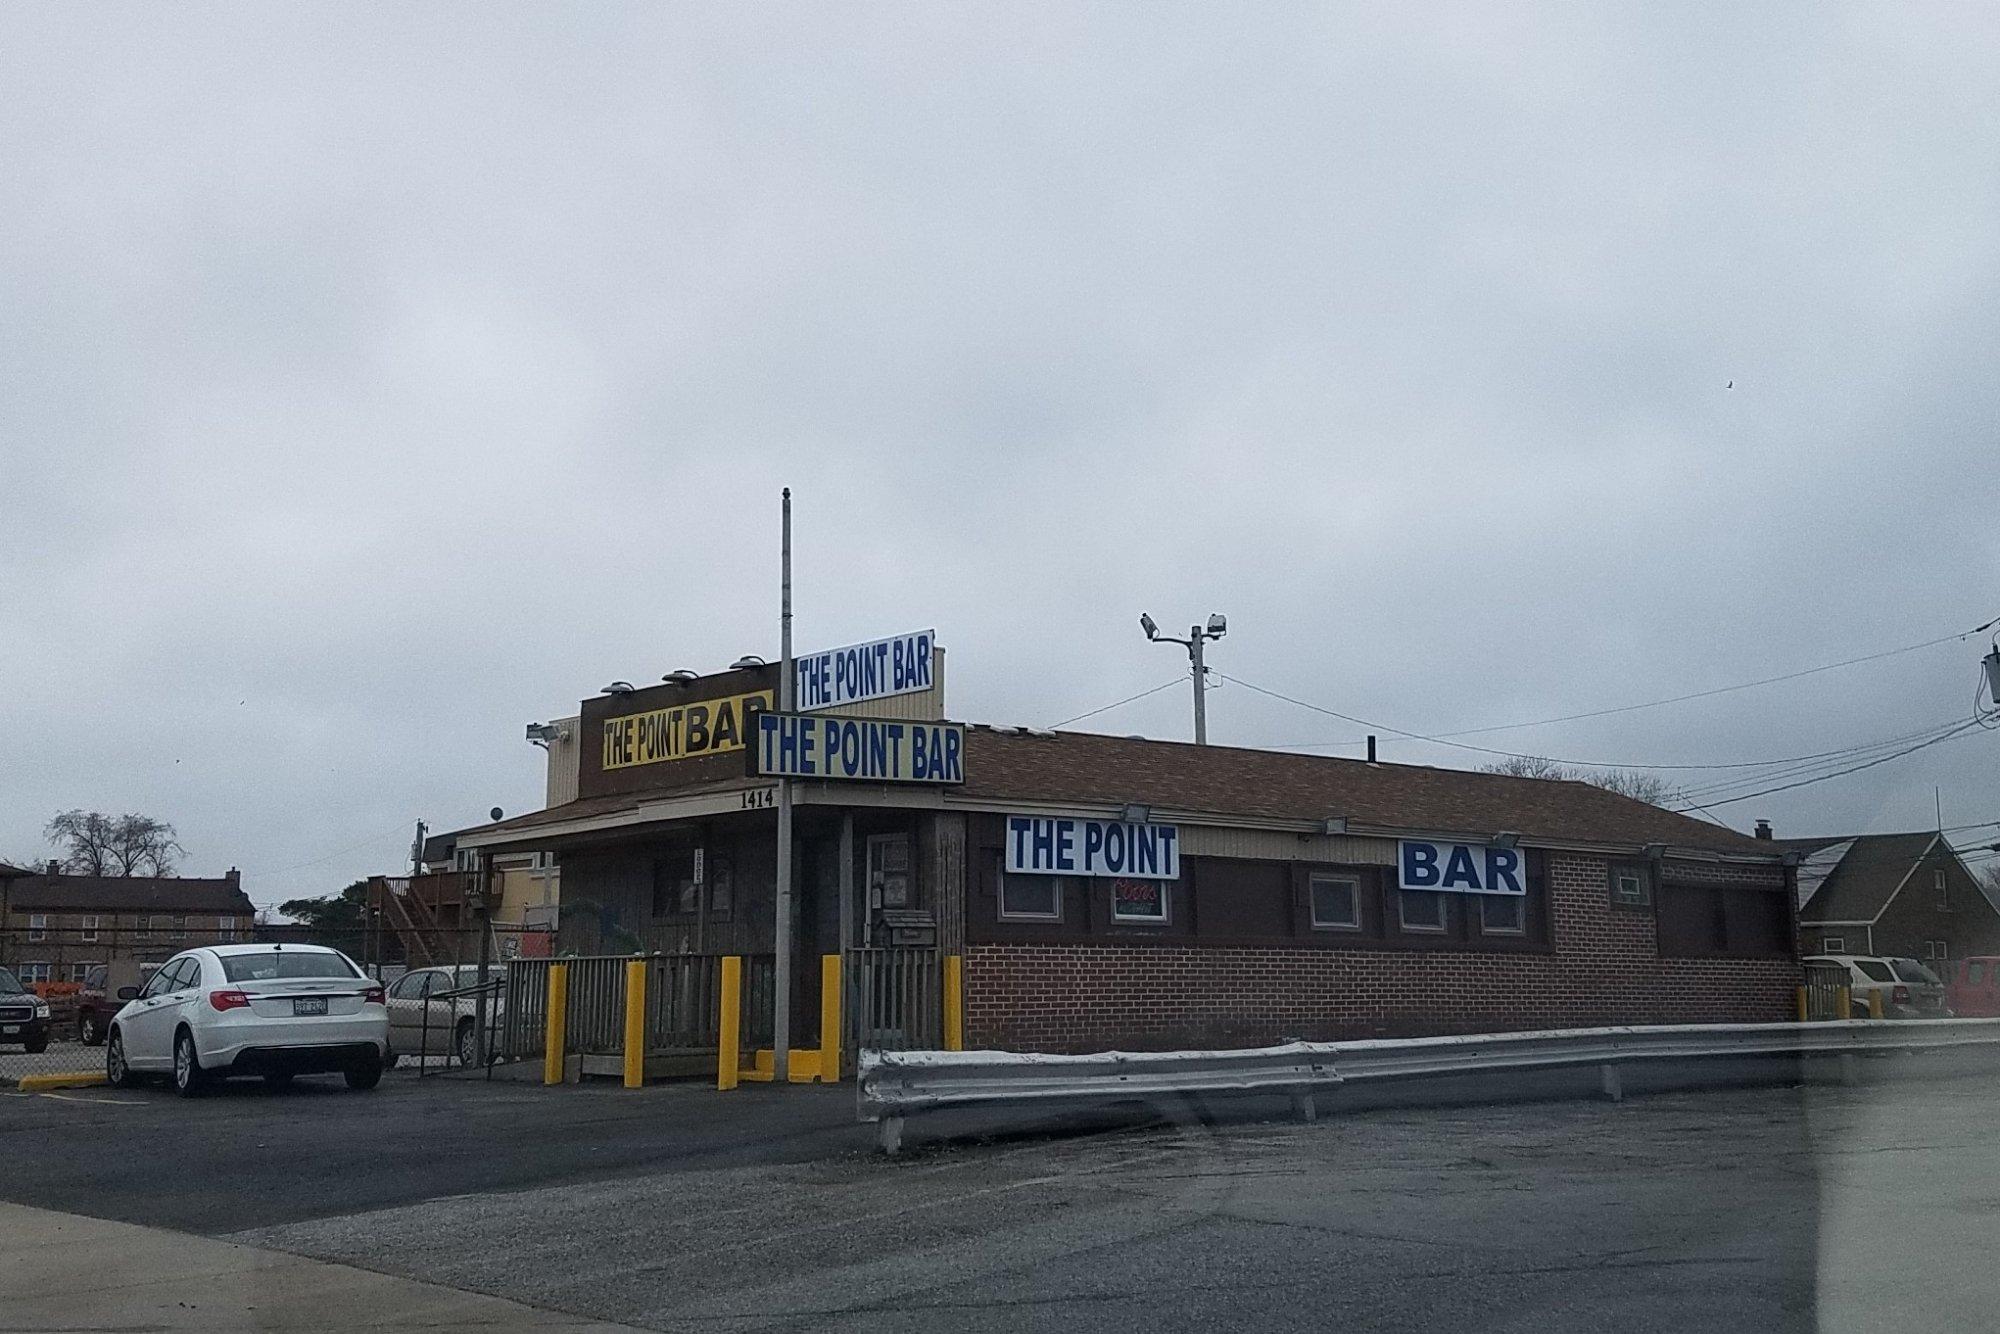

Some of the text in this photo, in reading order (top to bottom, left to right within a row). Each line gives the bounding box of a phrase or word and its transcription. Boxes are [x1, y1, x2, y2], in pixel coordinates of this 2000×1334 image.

[800, 635, 930, 707] THE POINT BAR
[605, 719, 633, 766] THE
[638, 709, 684, 761] POINT
[761, 715, 961, 781] THE POINT BAR
[741, 788, 773, 808] 1414
[1011, 818, 1176, 875] THE POINT
[1403, 842, 1521, 891] BAR
